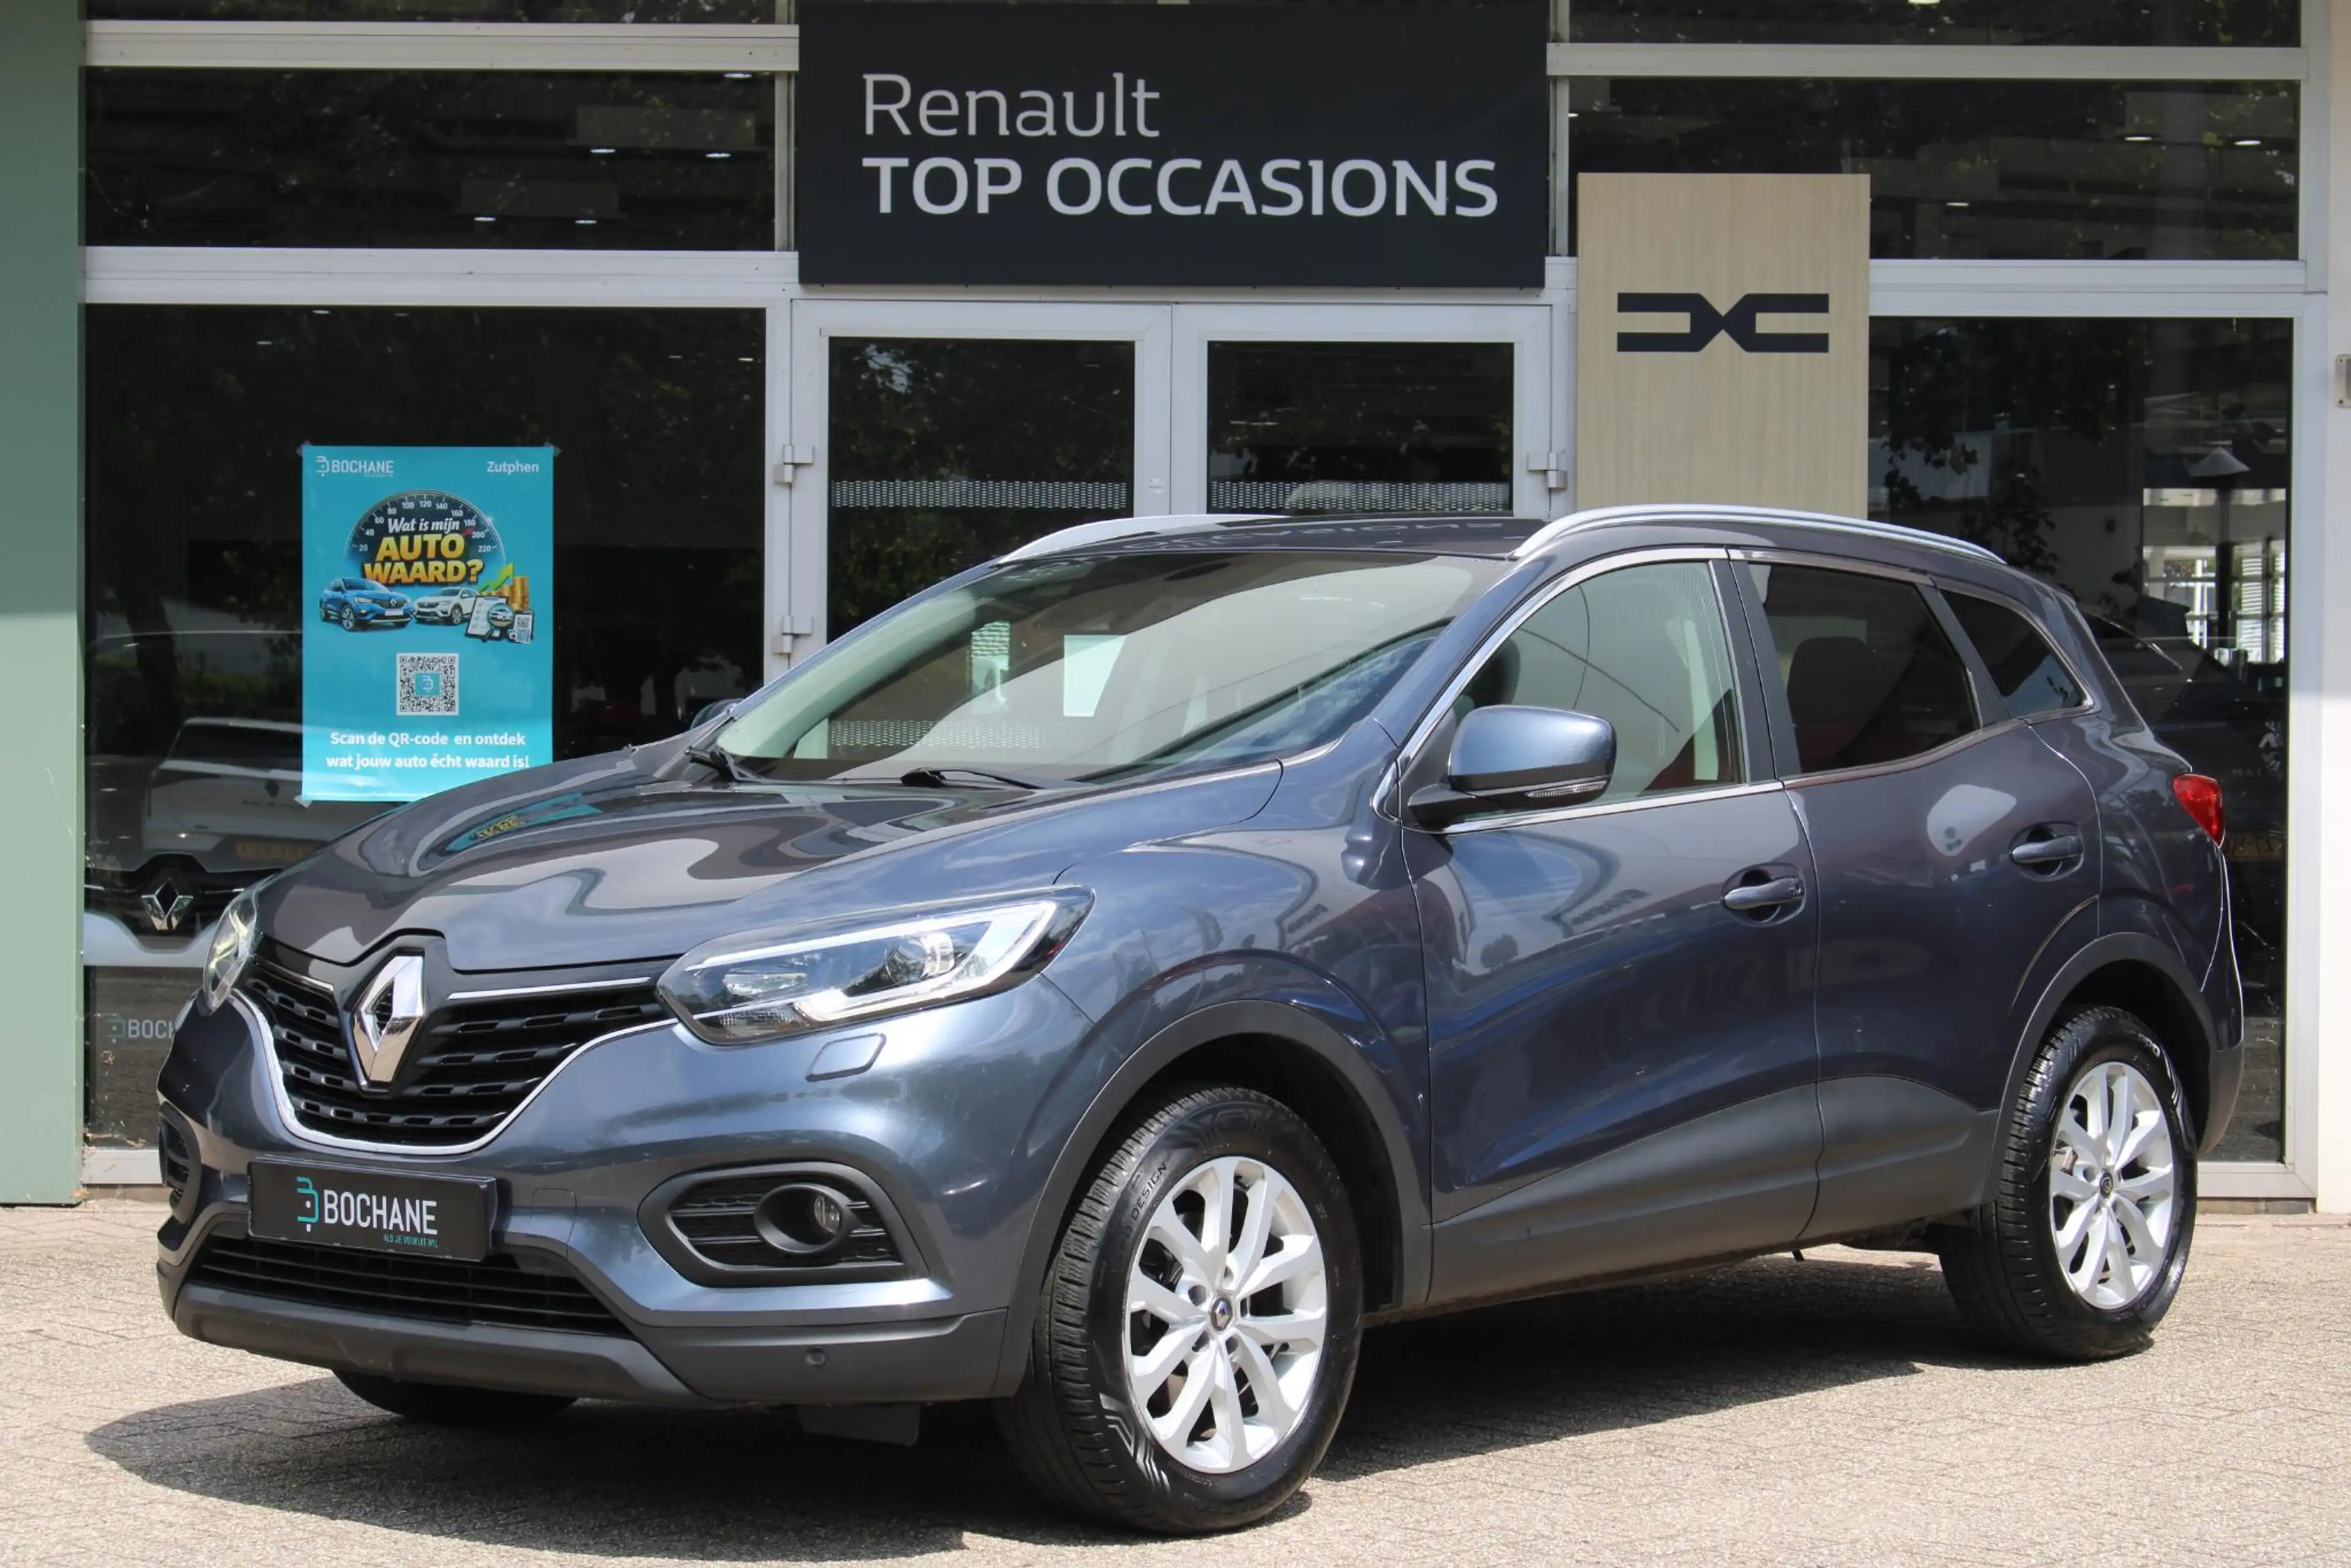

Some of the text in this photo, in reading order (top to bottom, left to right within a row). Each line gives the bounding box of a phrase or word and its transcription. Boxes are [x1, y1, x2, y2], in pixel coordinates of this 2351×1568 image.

[863, 72, 1159, 137] Renault
[863, 157, 1498, 217] TOP OCCASIONS
[331, 460, 395, 473] BOCHANE
[487, 461, 539, 475] Zutphen
[388, 517, 460, 535] Wat is mijn
[375, 533, 465, 561] AUTO
[364, 559, 483, 584] WAARD?
[330, 732, 526, 748] Scan de QR-code en ontdek
[326, 753, 530, 770] wat jouw auto écht waard is!
[1131, 1161, 1167, 1220] DESIGN
[323, 1189, 438, 1235] BOCHANE
